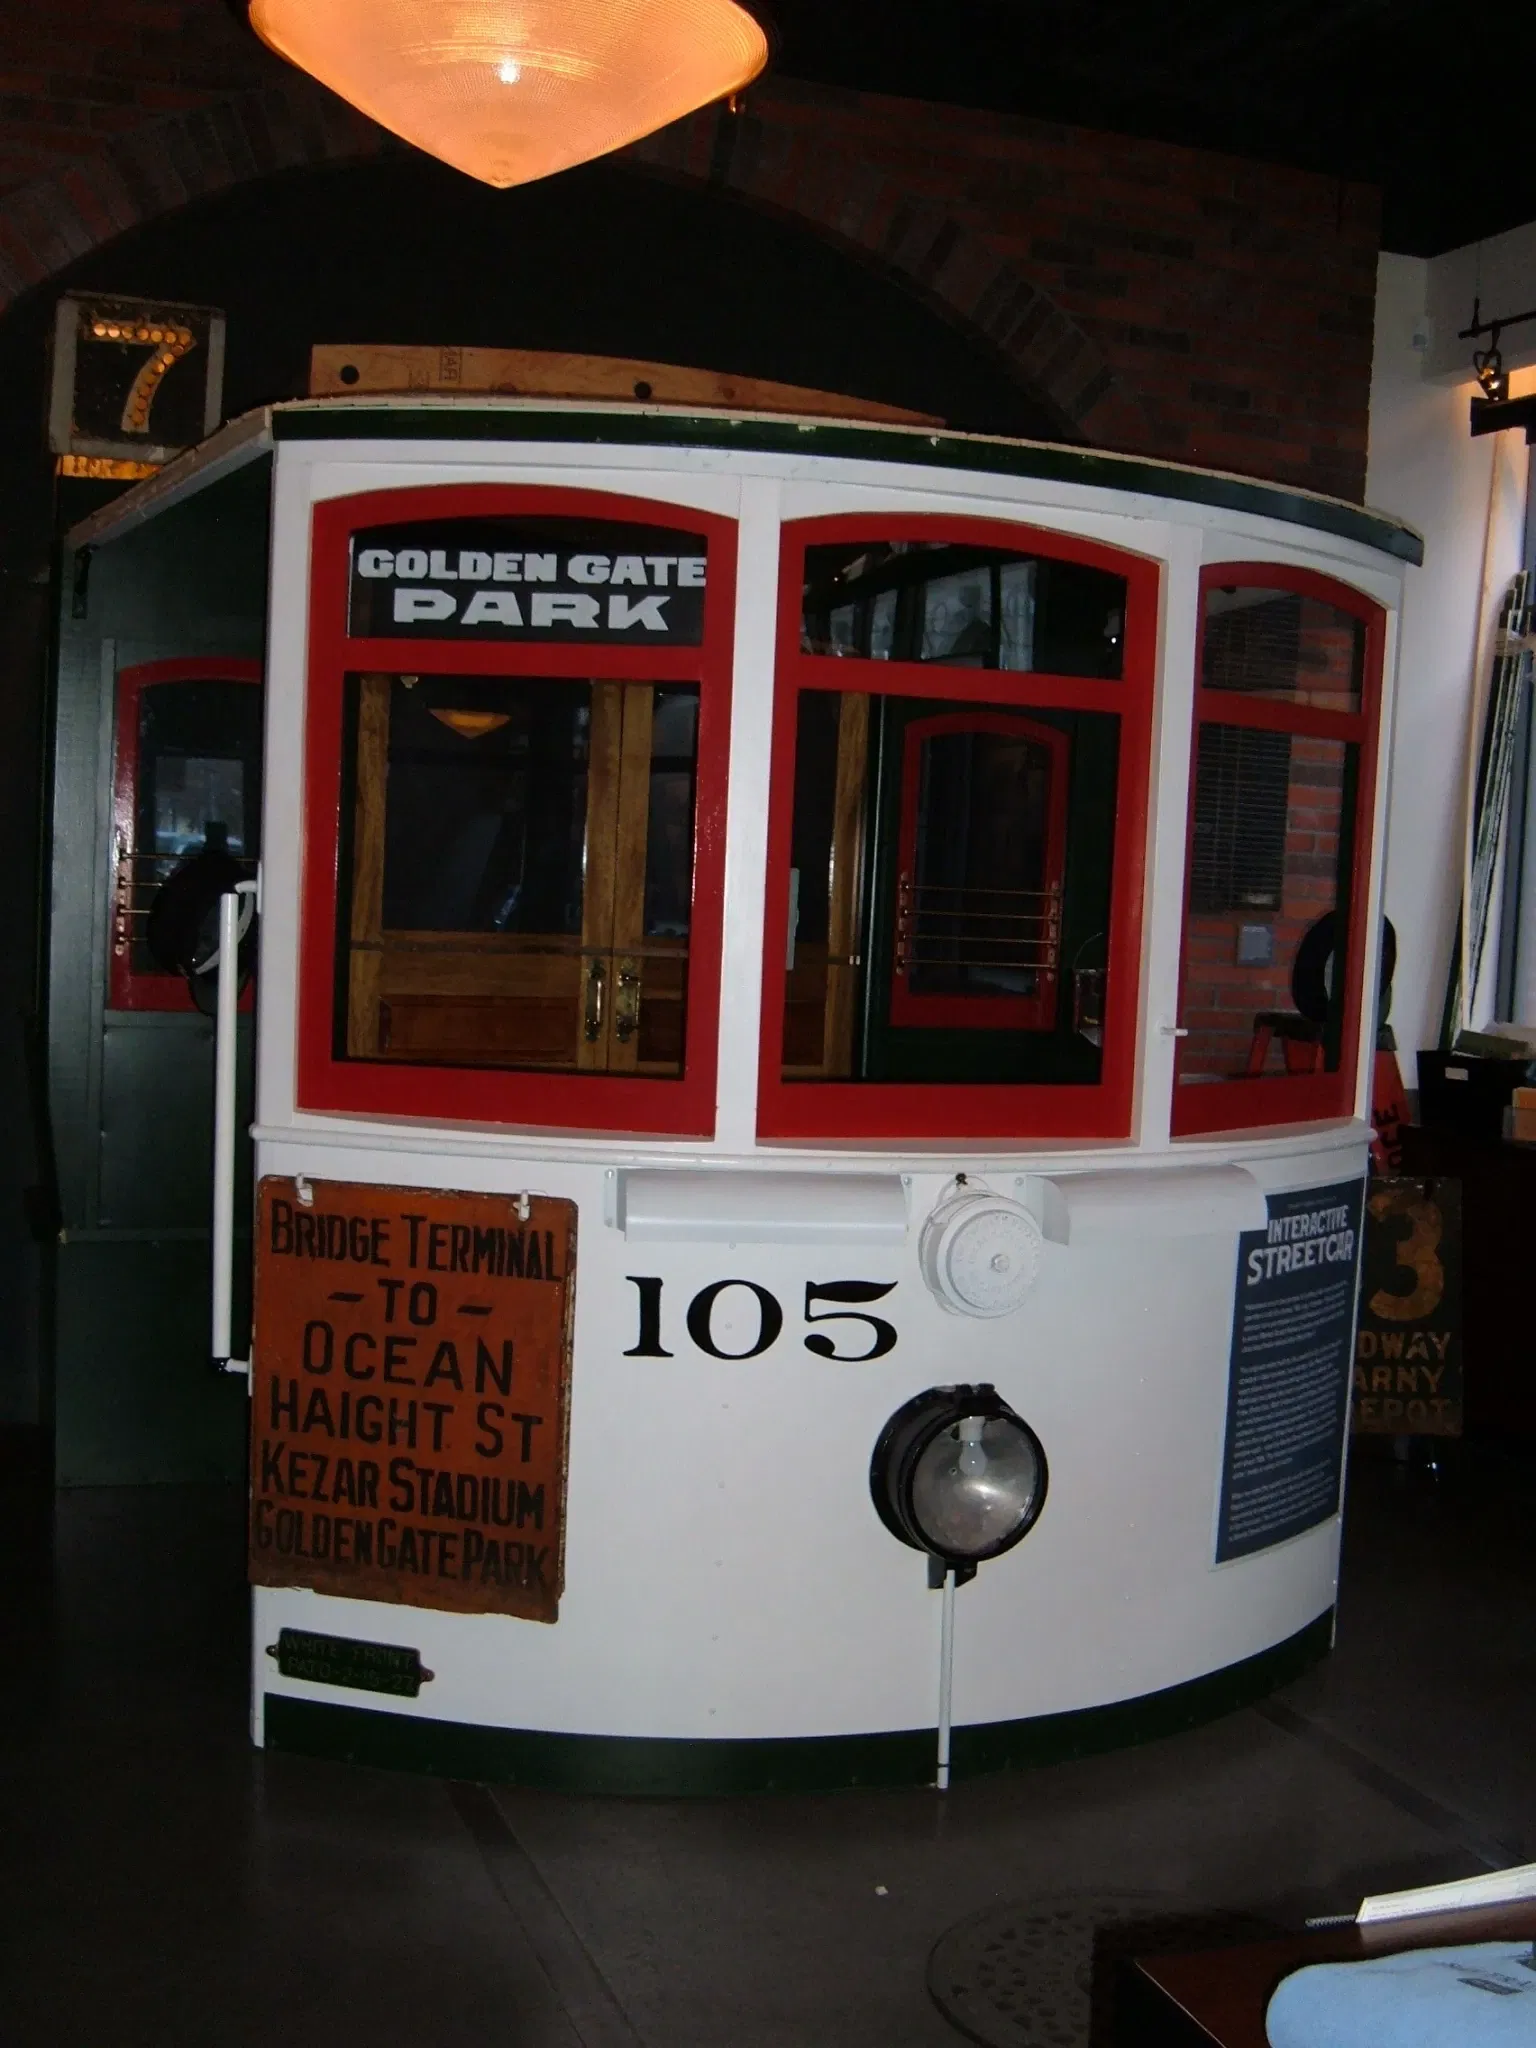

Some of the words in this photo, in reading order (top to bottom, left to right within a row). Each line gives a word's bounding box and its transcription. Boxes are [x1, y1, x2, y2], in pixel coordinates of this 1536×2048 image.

[80, 316, 198, 434] 7
[357, 548, 558, 583] GOLDEN
[567, 553, 708, 587] GATE
[393, 588, 671, 631] PARK
[271, 1198, 391, 1268] BRIDGE
[400, 1214, 563, 1282] TERMINAL
[1246, 1229, 1355, 1286] STREETCAR
[1267, 1204, 1349, 1245] INTERACTIVE
[1368, 1192, 1446, 1321] 3
[378, 1279, 438, 1326] TO
[622, 1275, 899, 1362] 105
[302, 1320, 514, 1396] OCEAN
[1357, 1329, 1453, 1360] DWAY
[1354, 1363, 1445, 1393] ARNY
[269, 1375, 455, 1453] HAIGHT
[474, 1402, 543, 1463] ST
[1359, 1397, 1450, 1429] EPOT
[261, 1440, 381, 1510] KEZAR
[388, 1456, 545, 1531] STADIUM
[253, 1500, 374, 1566] GOLDEN
[377, 1517, 458, 1580] GATE
[462, 1527, 550, 1590] PARK
